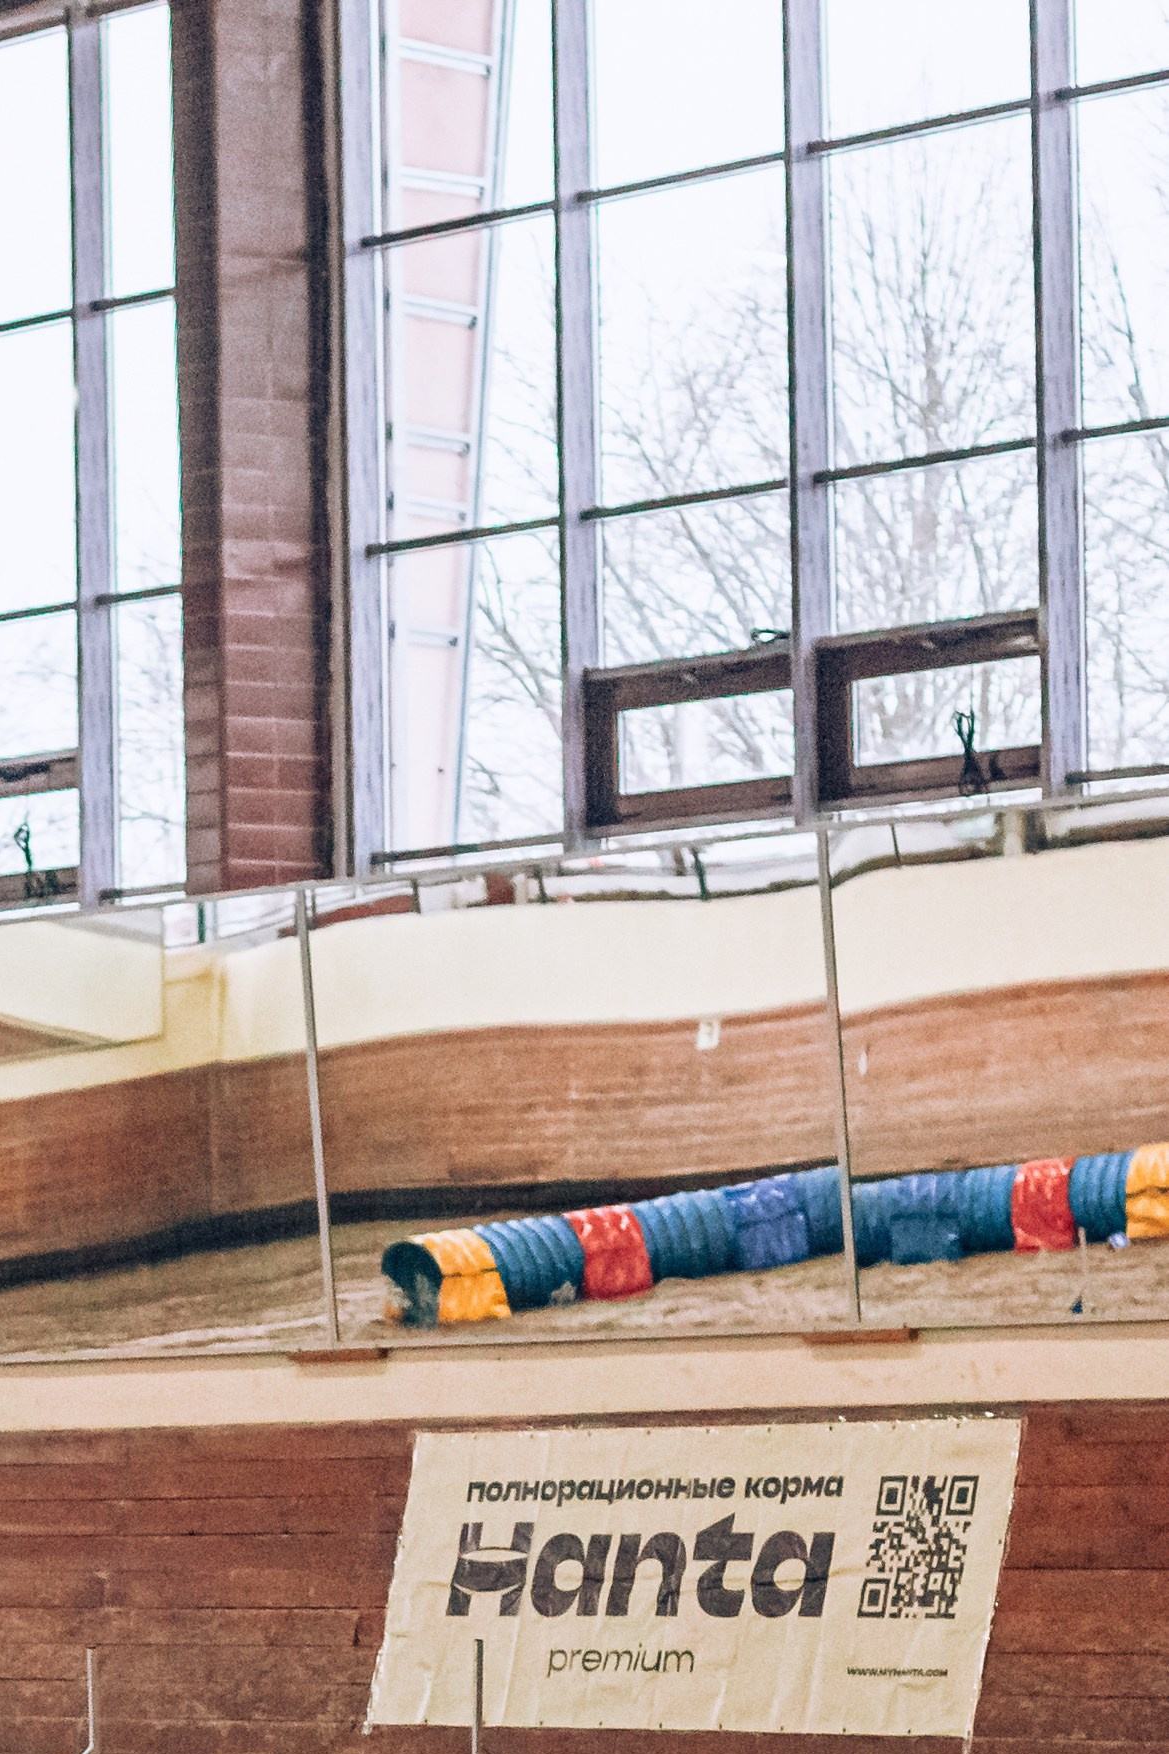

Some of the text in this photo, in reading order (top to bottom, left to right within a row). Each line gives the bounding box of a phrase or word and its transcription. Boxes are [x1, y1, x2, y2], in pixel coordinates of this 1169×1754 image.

[467, 1475, 844, 1506] полнорационные корма
[445, 1513, 836, 1618] Hanta
[546, 1644, 695, 1675] premium
